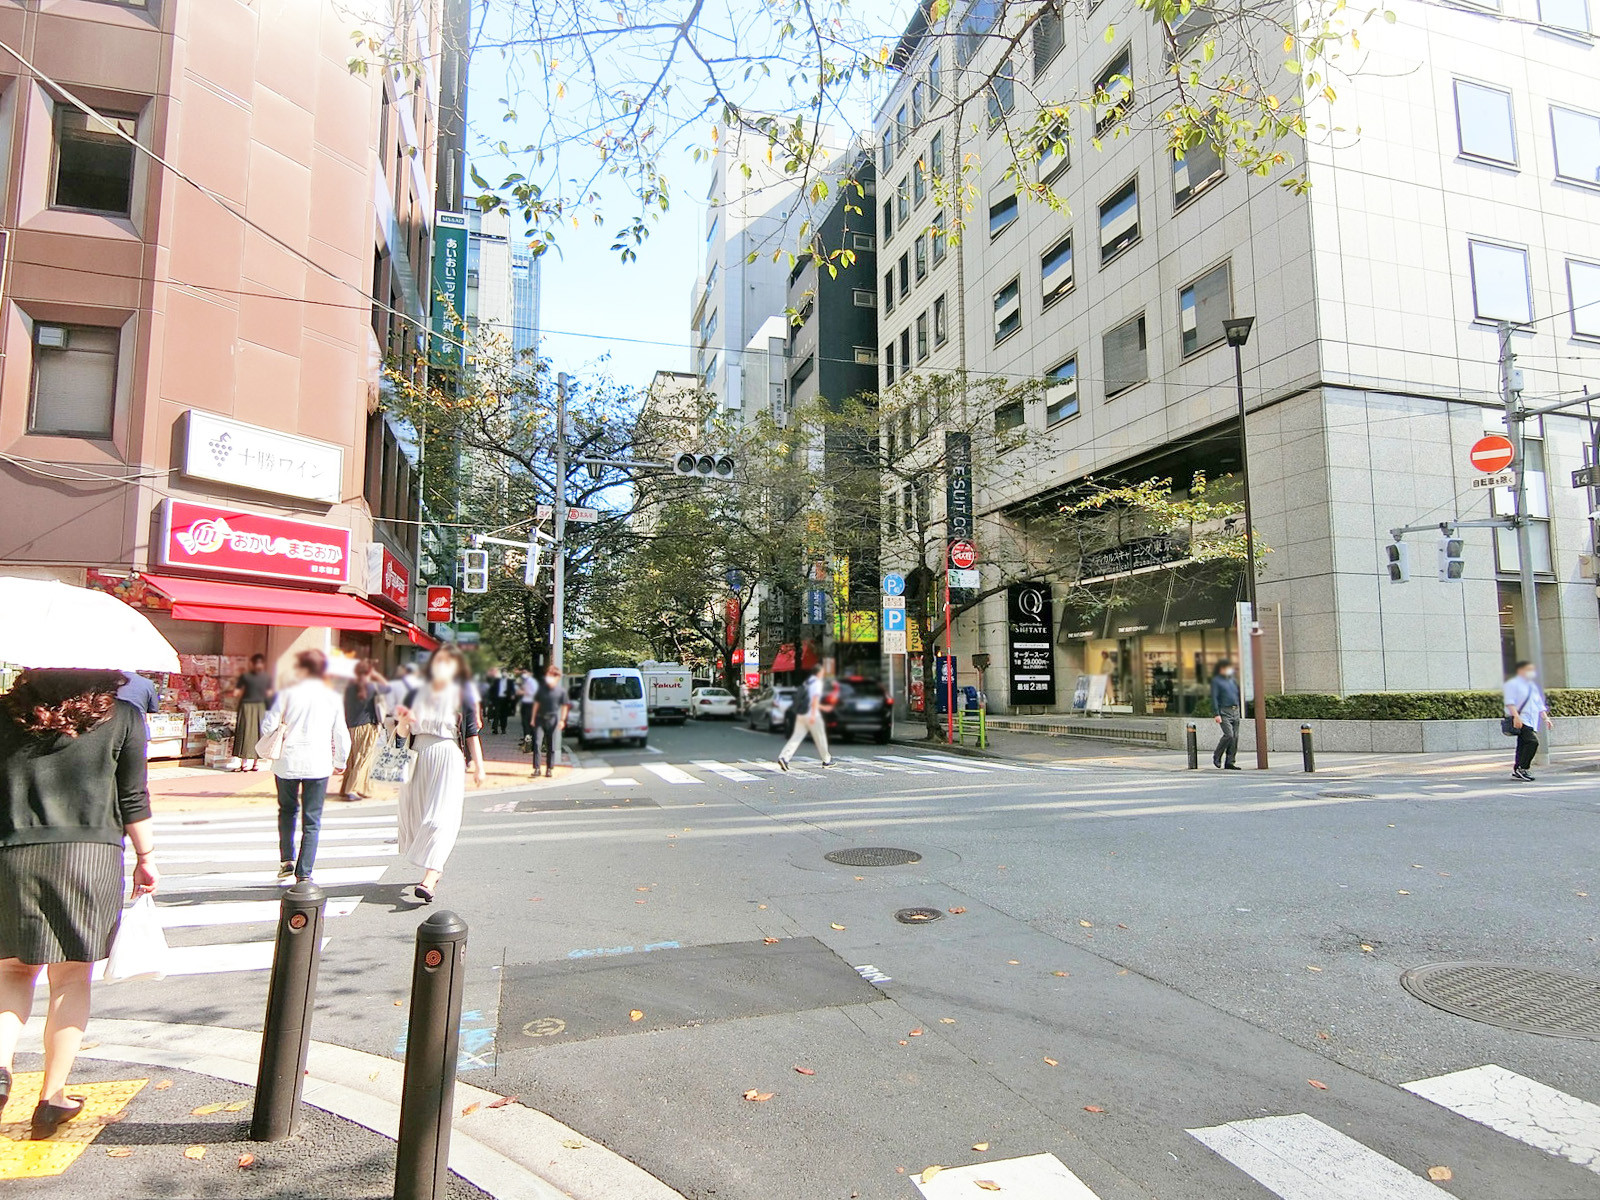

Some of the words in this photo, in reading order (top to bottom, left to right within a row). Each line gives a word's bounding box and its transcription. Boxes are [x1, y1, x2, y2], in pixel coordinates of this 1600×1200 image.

[442, 238, 457, 354] あいおいニッセ同和保
[238, 447, 323, 479] 十勝ワイン
[1472, 475, 1513, 488] 自転車を除く
[1574, 474, 1589, 486] 14
[953, 480, 966, 514] SUIT
[233, 533, 341, 562] おかしまちおか
[888, 610, 902, 629] P
[1013, 651, 1050, 659] オーダースーツ
